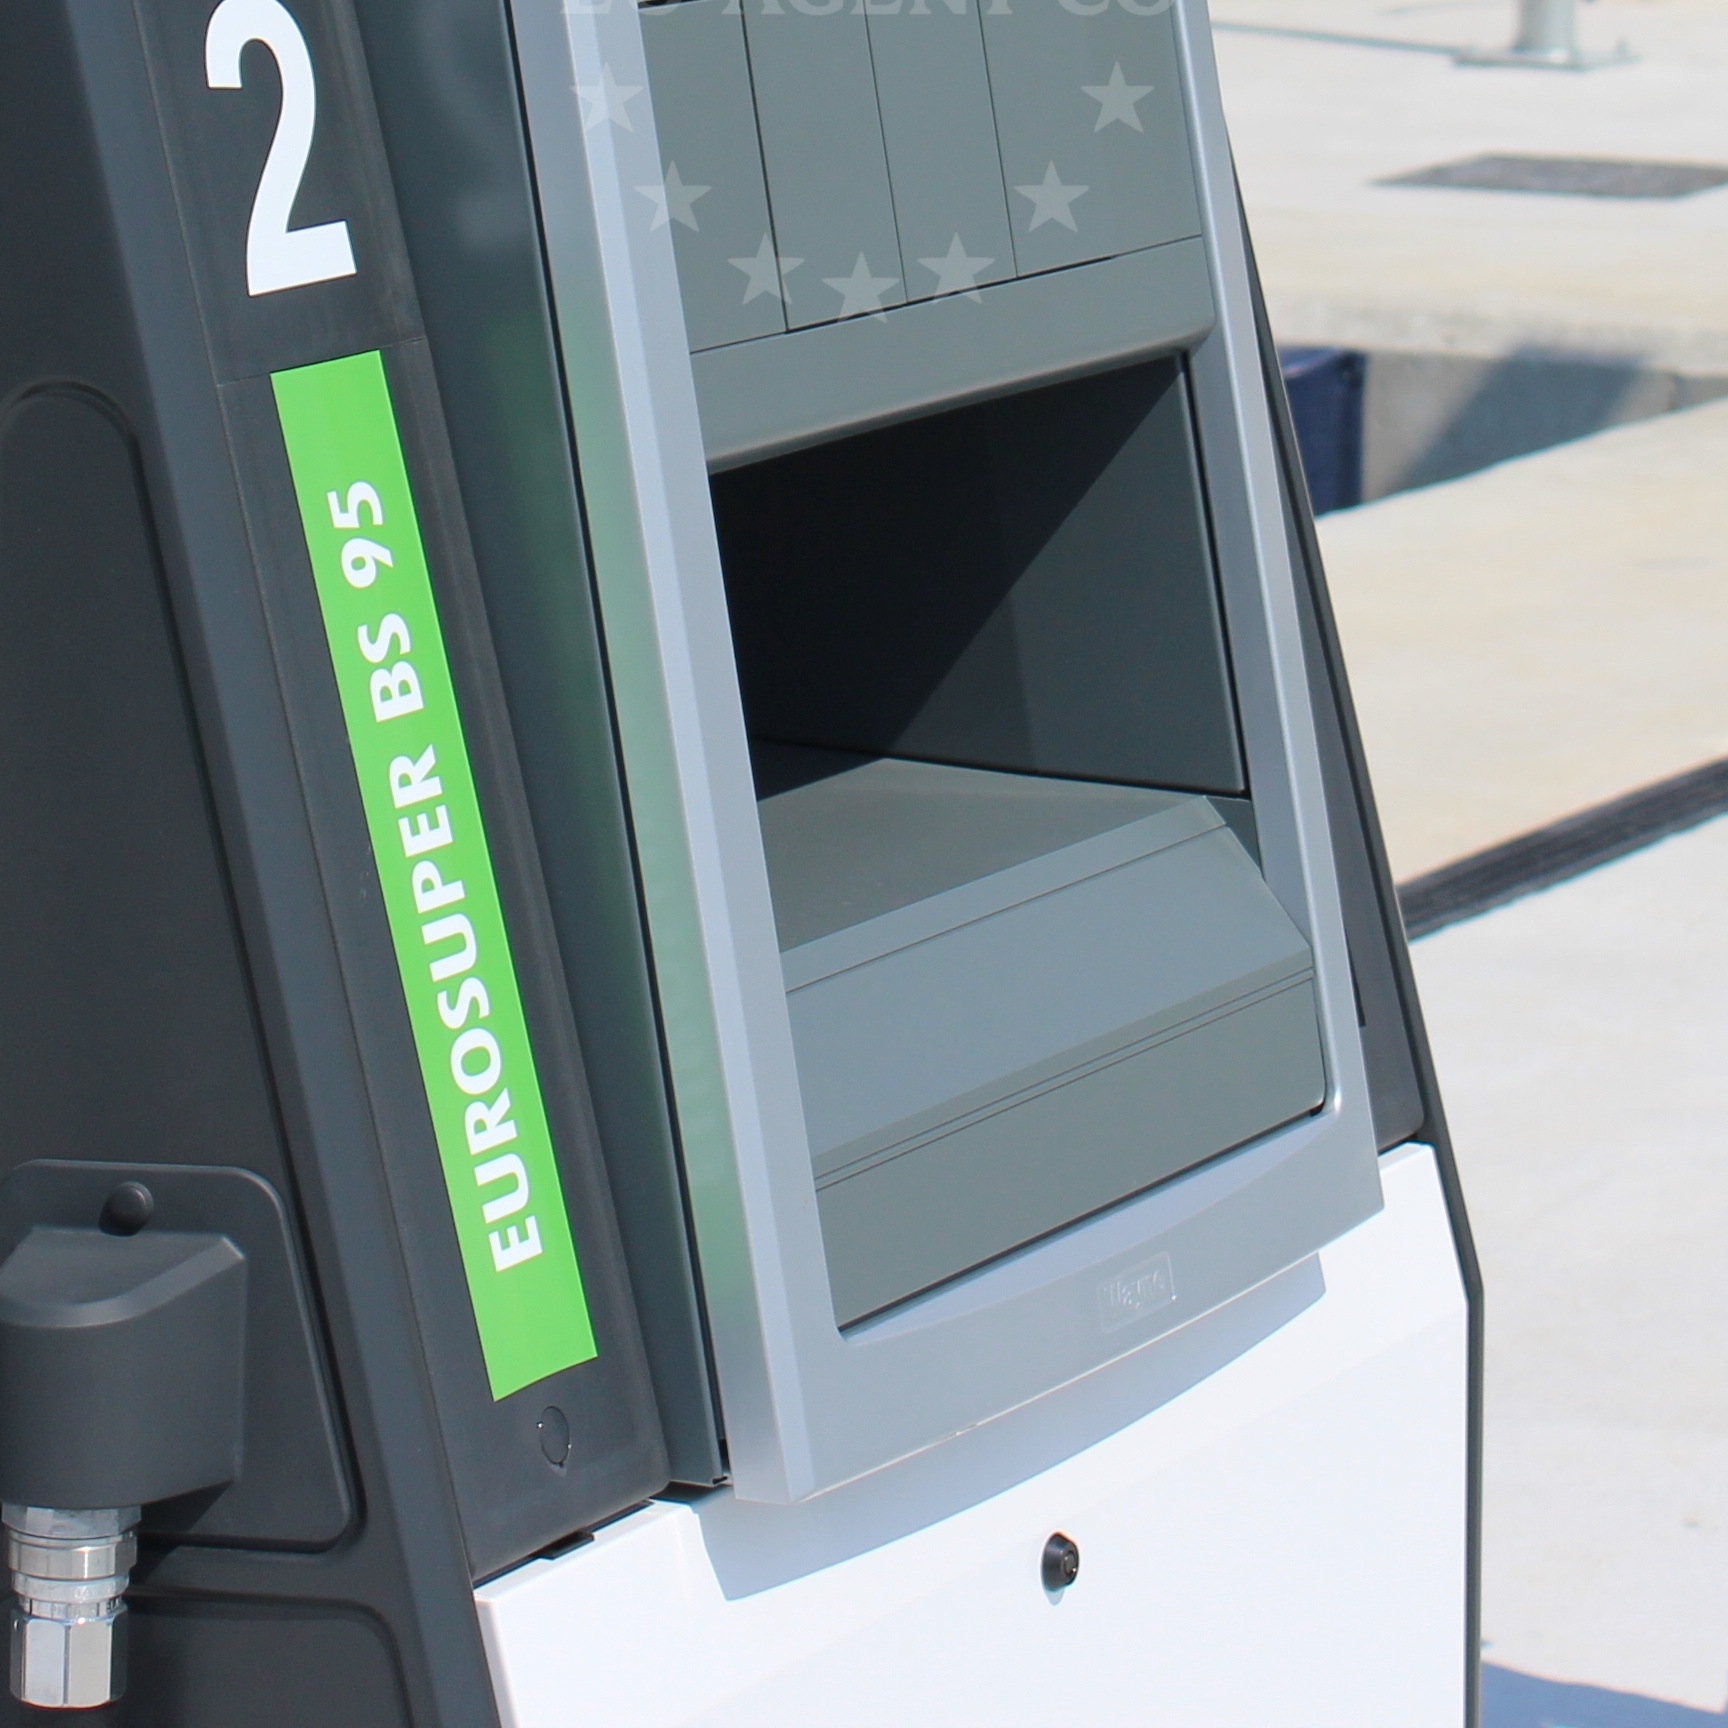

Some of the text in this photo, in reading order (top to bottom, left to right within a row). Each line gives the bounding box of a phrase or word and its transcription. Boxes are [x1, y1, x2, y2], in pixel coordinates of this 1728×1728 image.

[327, 480, 543, 1273] EUROSUPER BS 95
